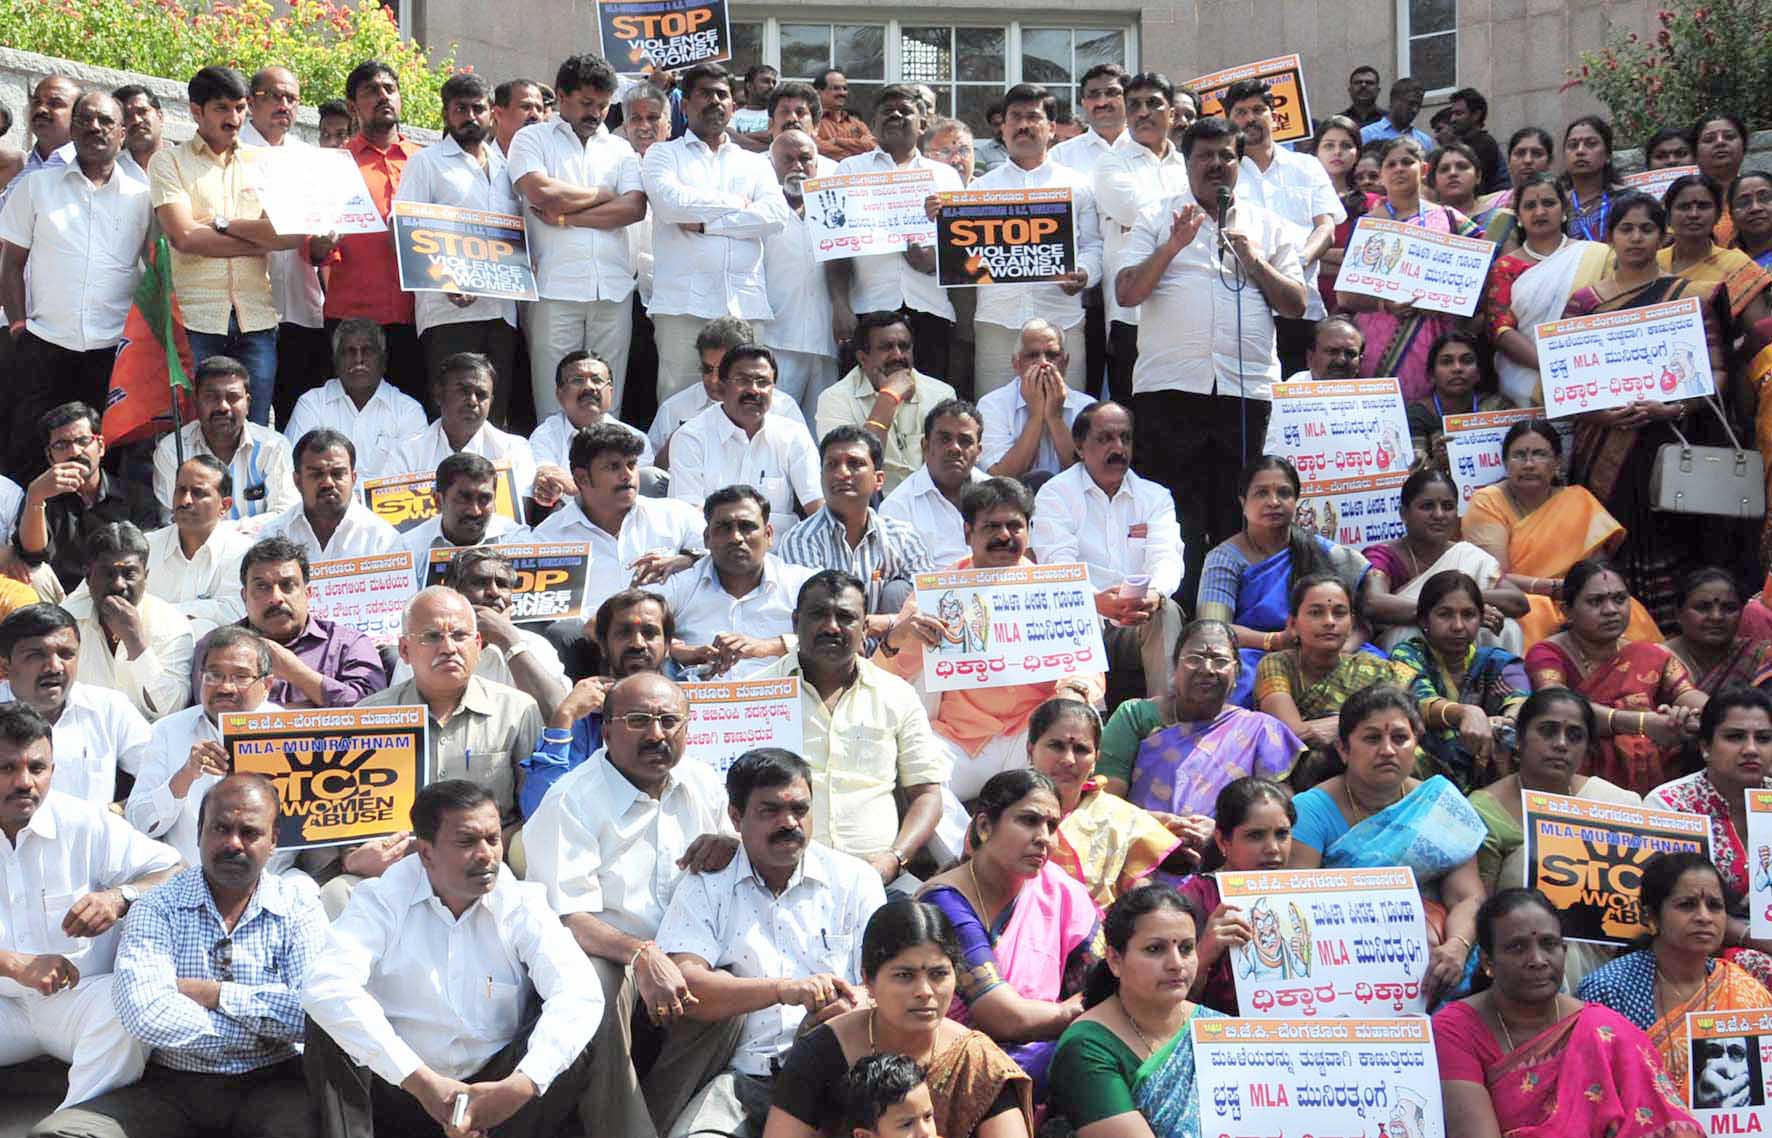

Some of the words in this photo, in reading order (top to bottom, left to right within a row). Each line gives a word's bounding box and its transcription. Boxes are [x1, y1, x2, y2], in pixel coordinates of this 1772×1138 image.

[612, 8, 712, 39] STOP
[628, 28, 718, 49] VIOLENCE
[640, 39, 716, 58] AGAINST
[648, 47, 719, 67] WOMEN
[950, 218, 1058, 246] STOP
[410, 229, 513, 262] STOP
[965, 244, 1064, 257] VIOLENCE
[427, 254, 520, 274] VIOLENCE
[978, 255, 1064, 268] AGAINST
[989, 265, 1065, 278] WOMEN
[1399, 261, 1422, 278] MLA
[441, 264, 522, 280] AGAINST
[453, 270, 526, 293] WOMEN
[1573, 353, 1600, 368] MLA
[1304, 422, 1327, 438] MLA
[1479, 453, 1502, 467] MLA
[1340, 526, 1362, 545] MLA
[512, 569, 569, 592] OP
[512, 590, 572, 602] ENCE
[993, 623, 1022, 644] MLA
[239, 736, 410, 754] MLA-MUNIRATHNAM
[280, 796, 394, 817] WOMEN
[308, 809, 393, 828] ABUSE
[1540, 821, 1697, 854] MLA-MUNIRATHNAM
[1541, 853, 1643, 897] STO
[1317, 939, 1351, 966] MLA
[1249, 1083, 1289, 1108] MLA
[1711, 1112, 1762, 1135] MLA
